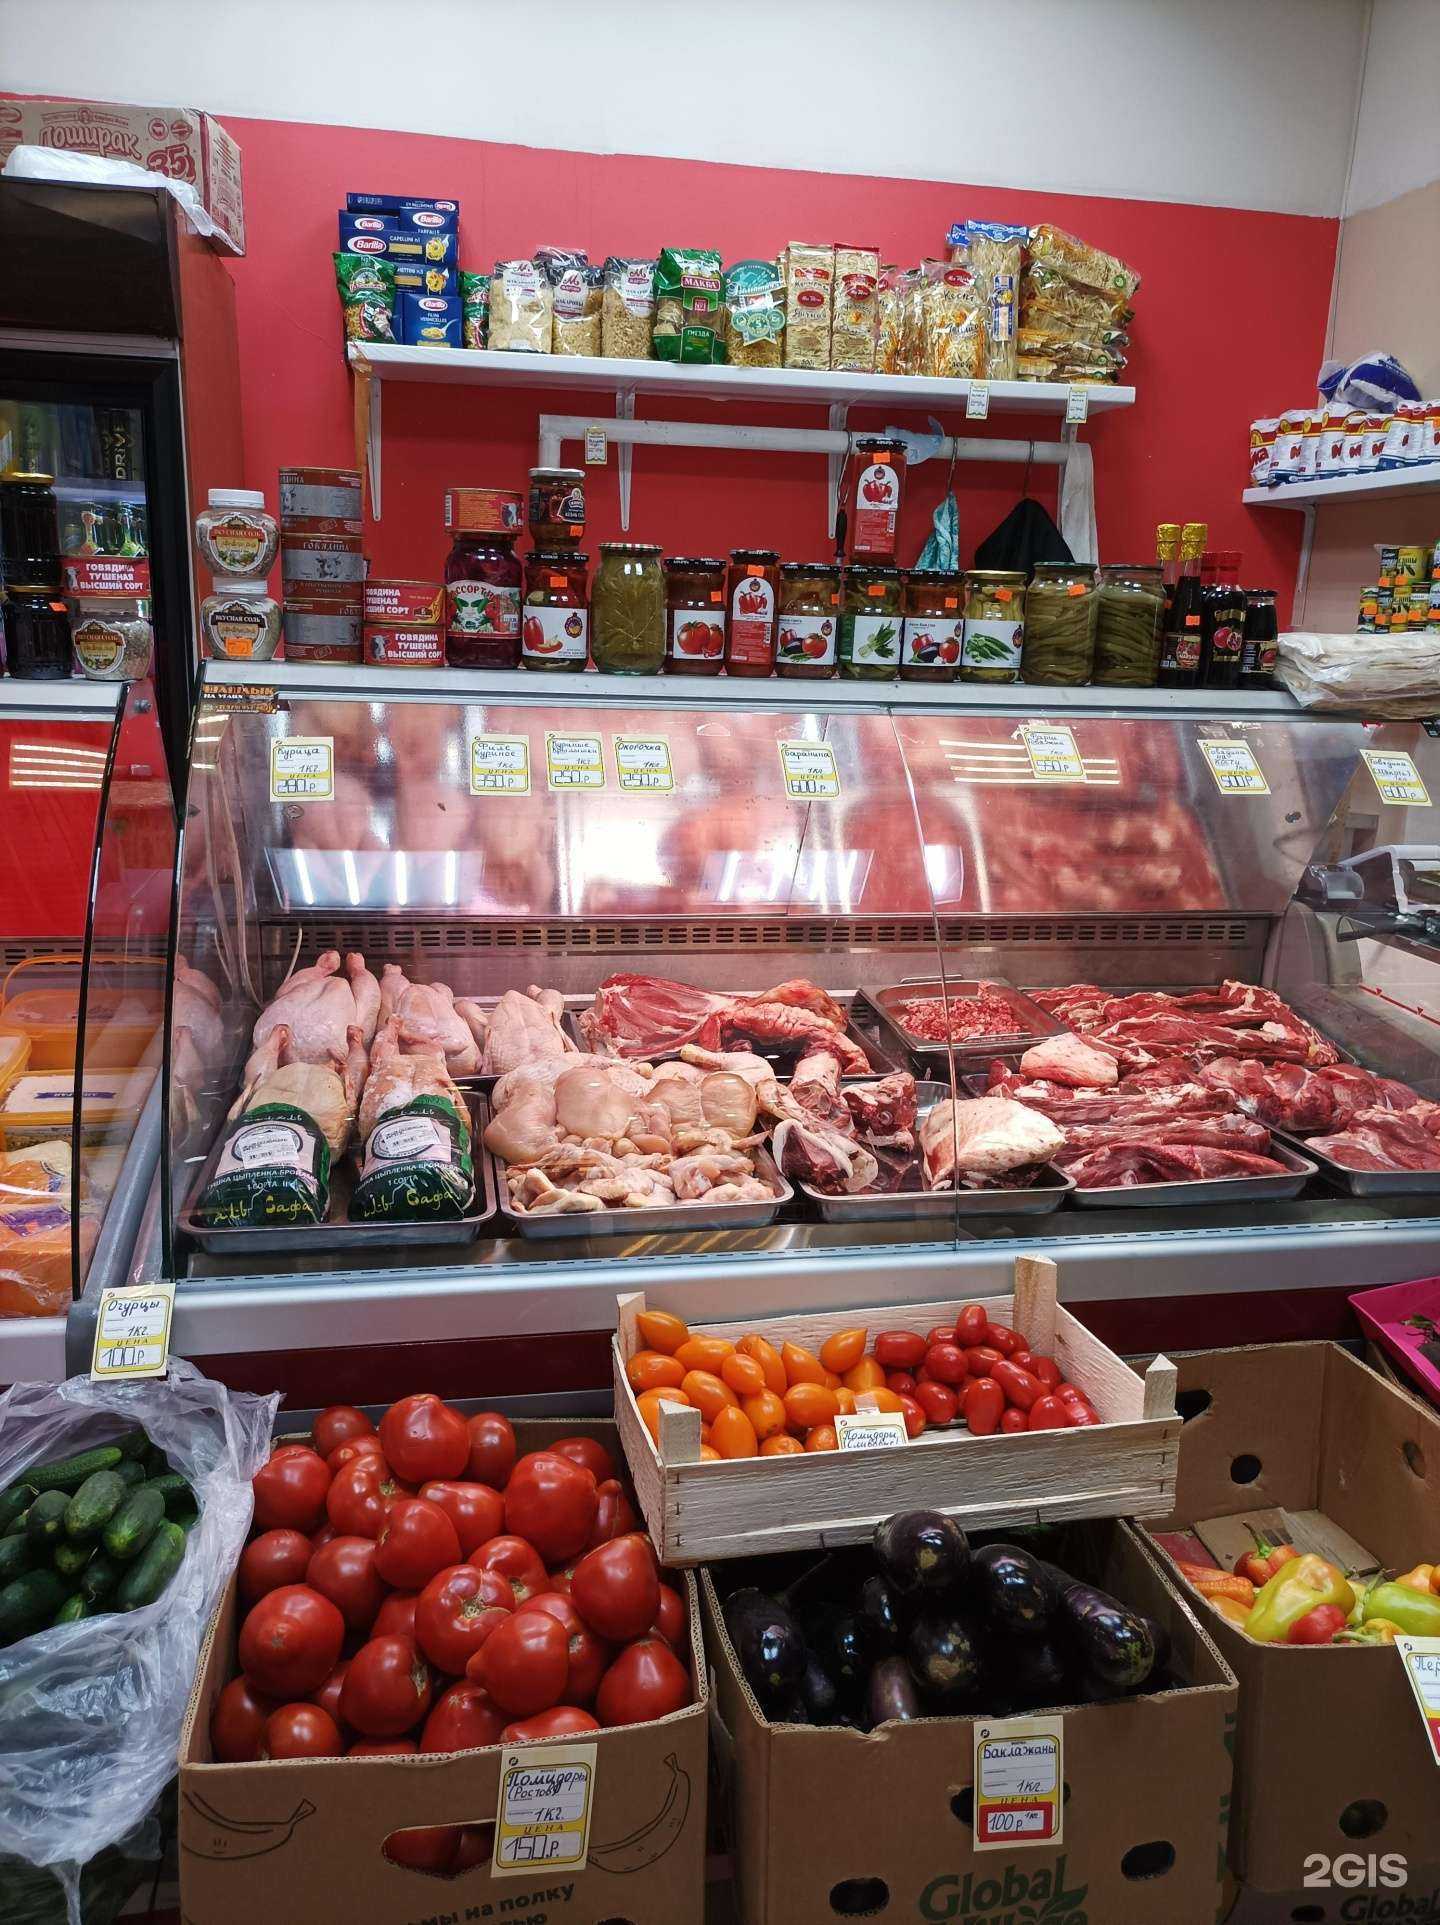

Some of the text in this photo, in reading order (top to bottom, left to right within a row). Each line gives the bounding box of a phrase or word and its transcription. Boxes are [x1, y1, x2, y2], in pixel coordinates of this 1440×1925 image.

[361, 220, 382, 229] Barilla
[420, 215, 444, 225] Barilla
[356, 239, 384, 250] Barilla
[425, 300, 445, 308] Barilla
[303, 541, 351, 552] ГОВЯДИНА
[86, 563, 135, 573] ГОВЯДИНА
[89, 573, 134, 582] ТУШЕНАЯ
[80, 582, 144, 590] ВЫСШИЙ СОРТ
[386, 606, 409, 614] СОРТ
[215, 615, 243, 623] ВКУСНАЯ
[395, 633, 439, 642] ГОВЯДИНА
[398, 642, 437, 650] ТУШЕНАЯ
[387, 649, 427, 658] ВЫСШИЙ
[233, 1170, 277, 1183] ЦЫПЛЕНКА
[374, 1165, 417, 1181] ЦЫПЛЕНКА
[252, 1180, 278, 1190] СОРТА
[393, 1175, 419, 1185] СОРТА
[107, 1300, 161, 1317] Огурцы
[983, 1744, 1057, 1760] Баклажаны
[507, 1770, 588, 1791] Помидоры
[523, 1825, 564, 1834] ЦЕНА
[919, 1854, 1080, 1921] Global
[465, 1905, 494, 1919] на
[500, 1883, 576, 1912] полку
